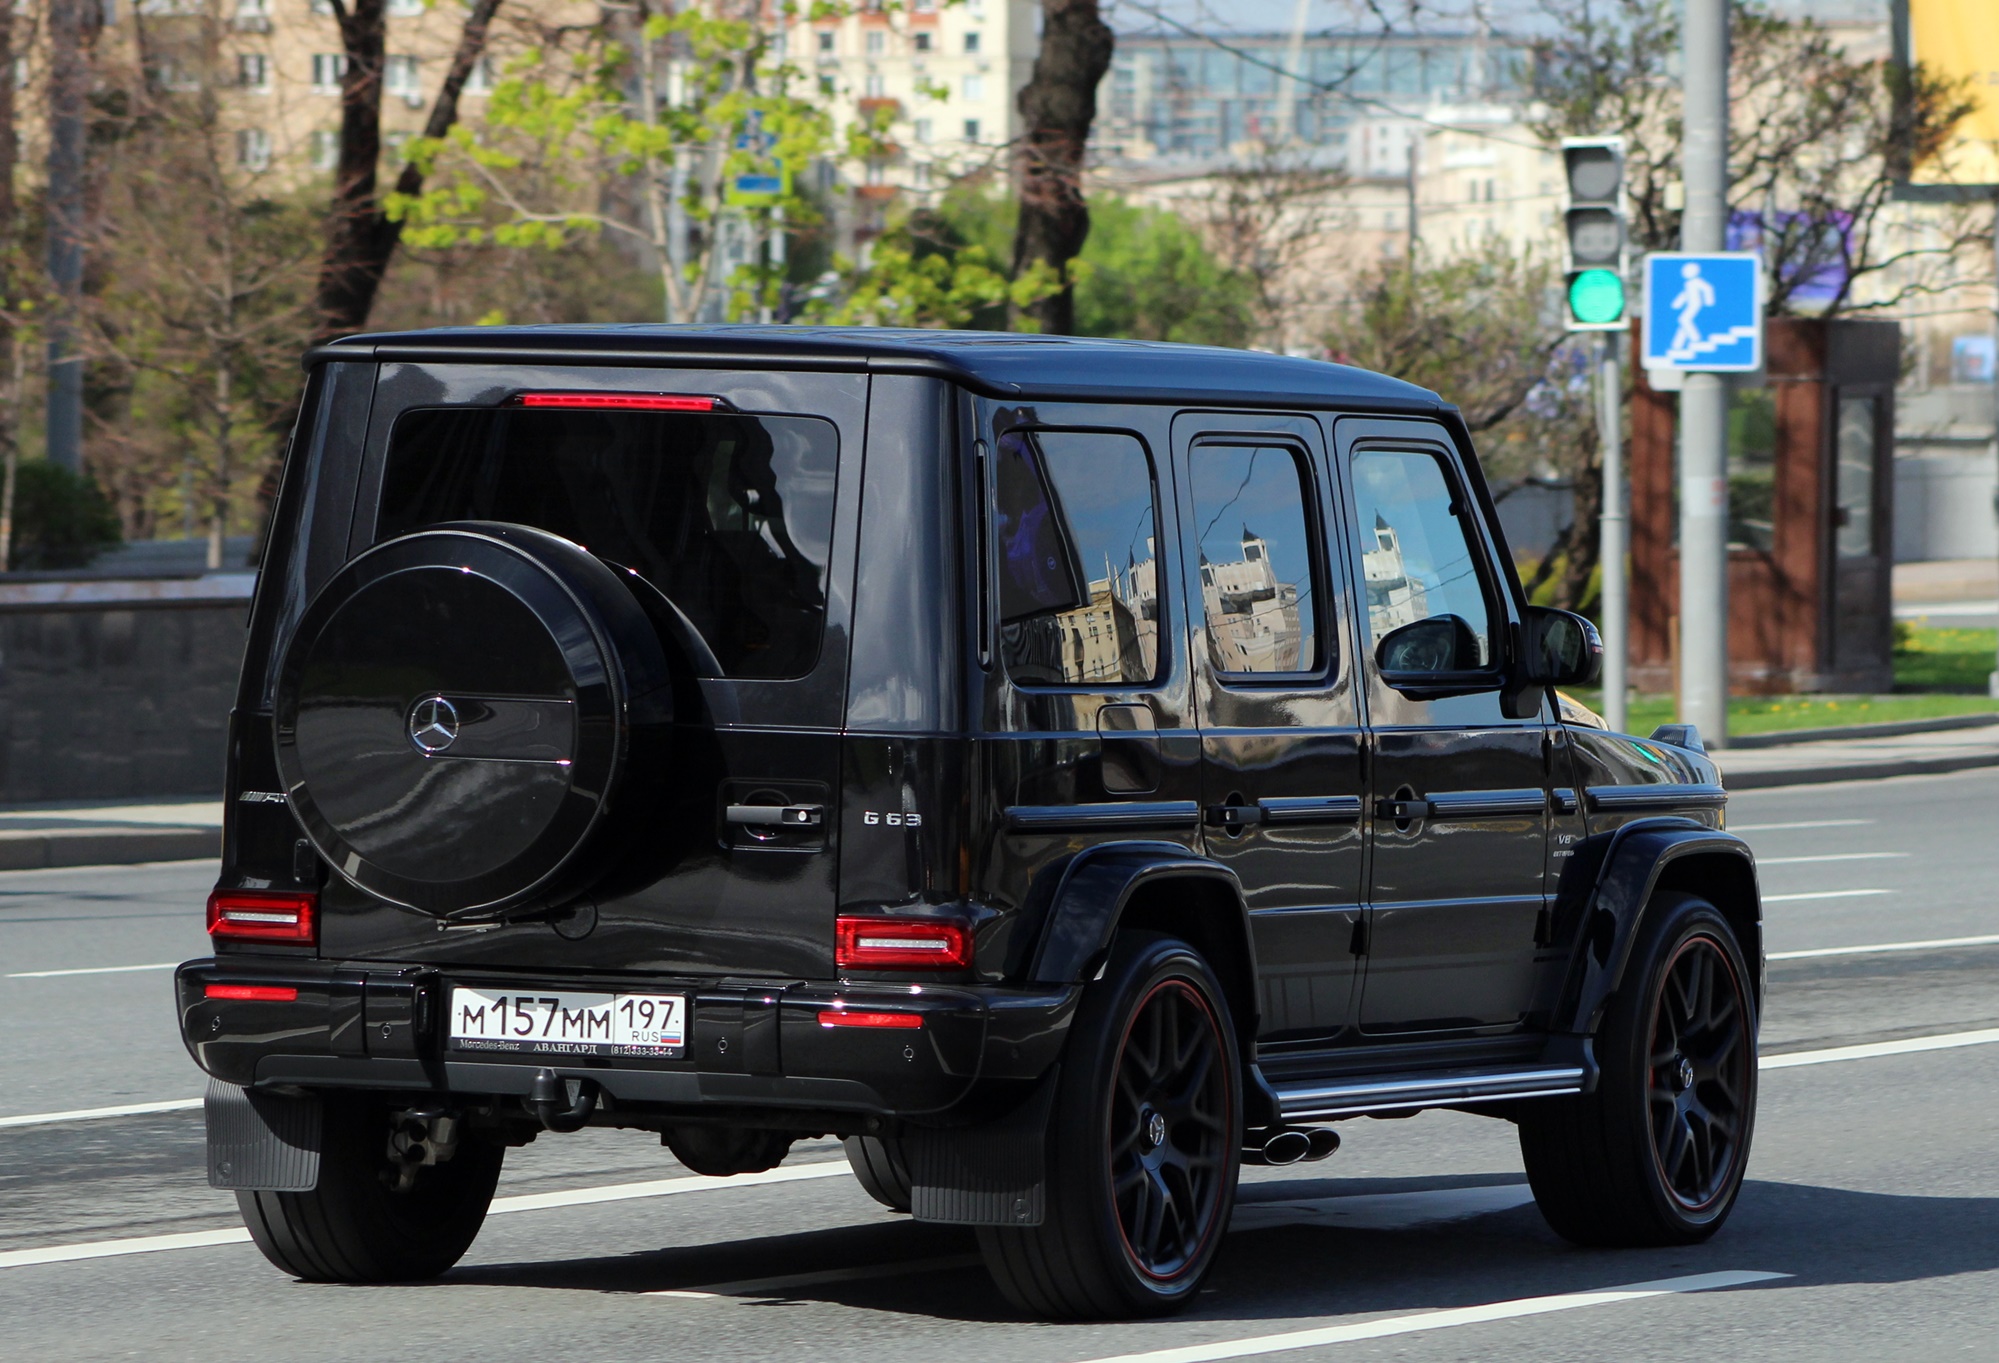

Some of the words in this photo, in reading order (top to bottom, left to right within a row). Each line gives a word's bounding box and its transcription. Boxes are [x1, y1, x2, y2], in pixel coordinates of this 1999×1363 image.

[863, 811, 879, 825] G
[886, 812, 922, 827] 63
[1558, 834, 1571, 844] V8
[620, 999, 674, 1030] 197
[632, 1030, 659, 1042] RUS
[460, 1039, 520, 1051] Mercedes-Benz
[533, 1043, 598, 1054] АВАНГАРД
